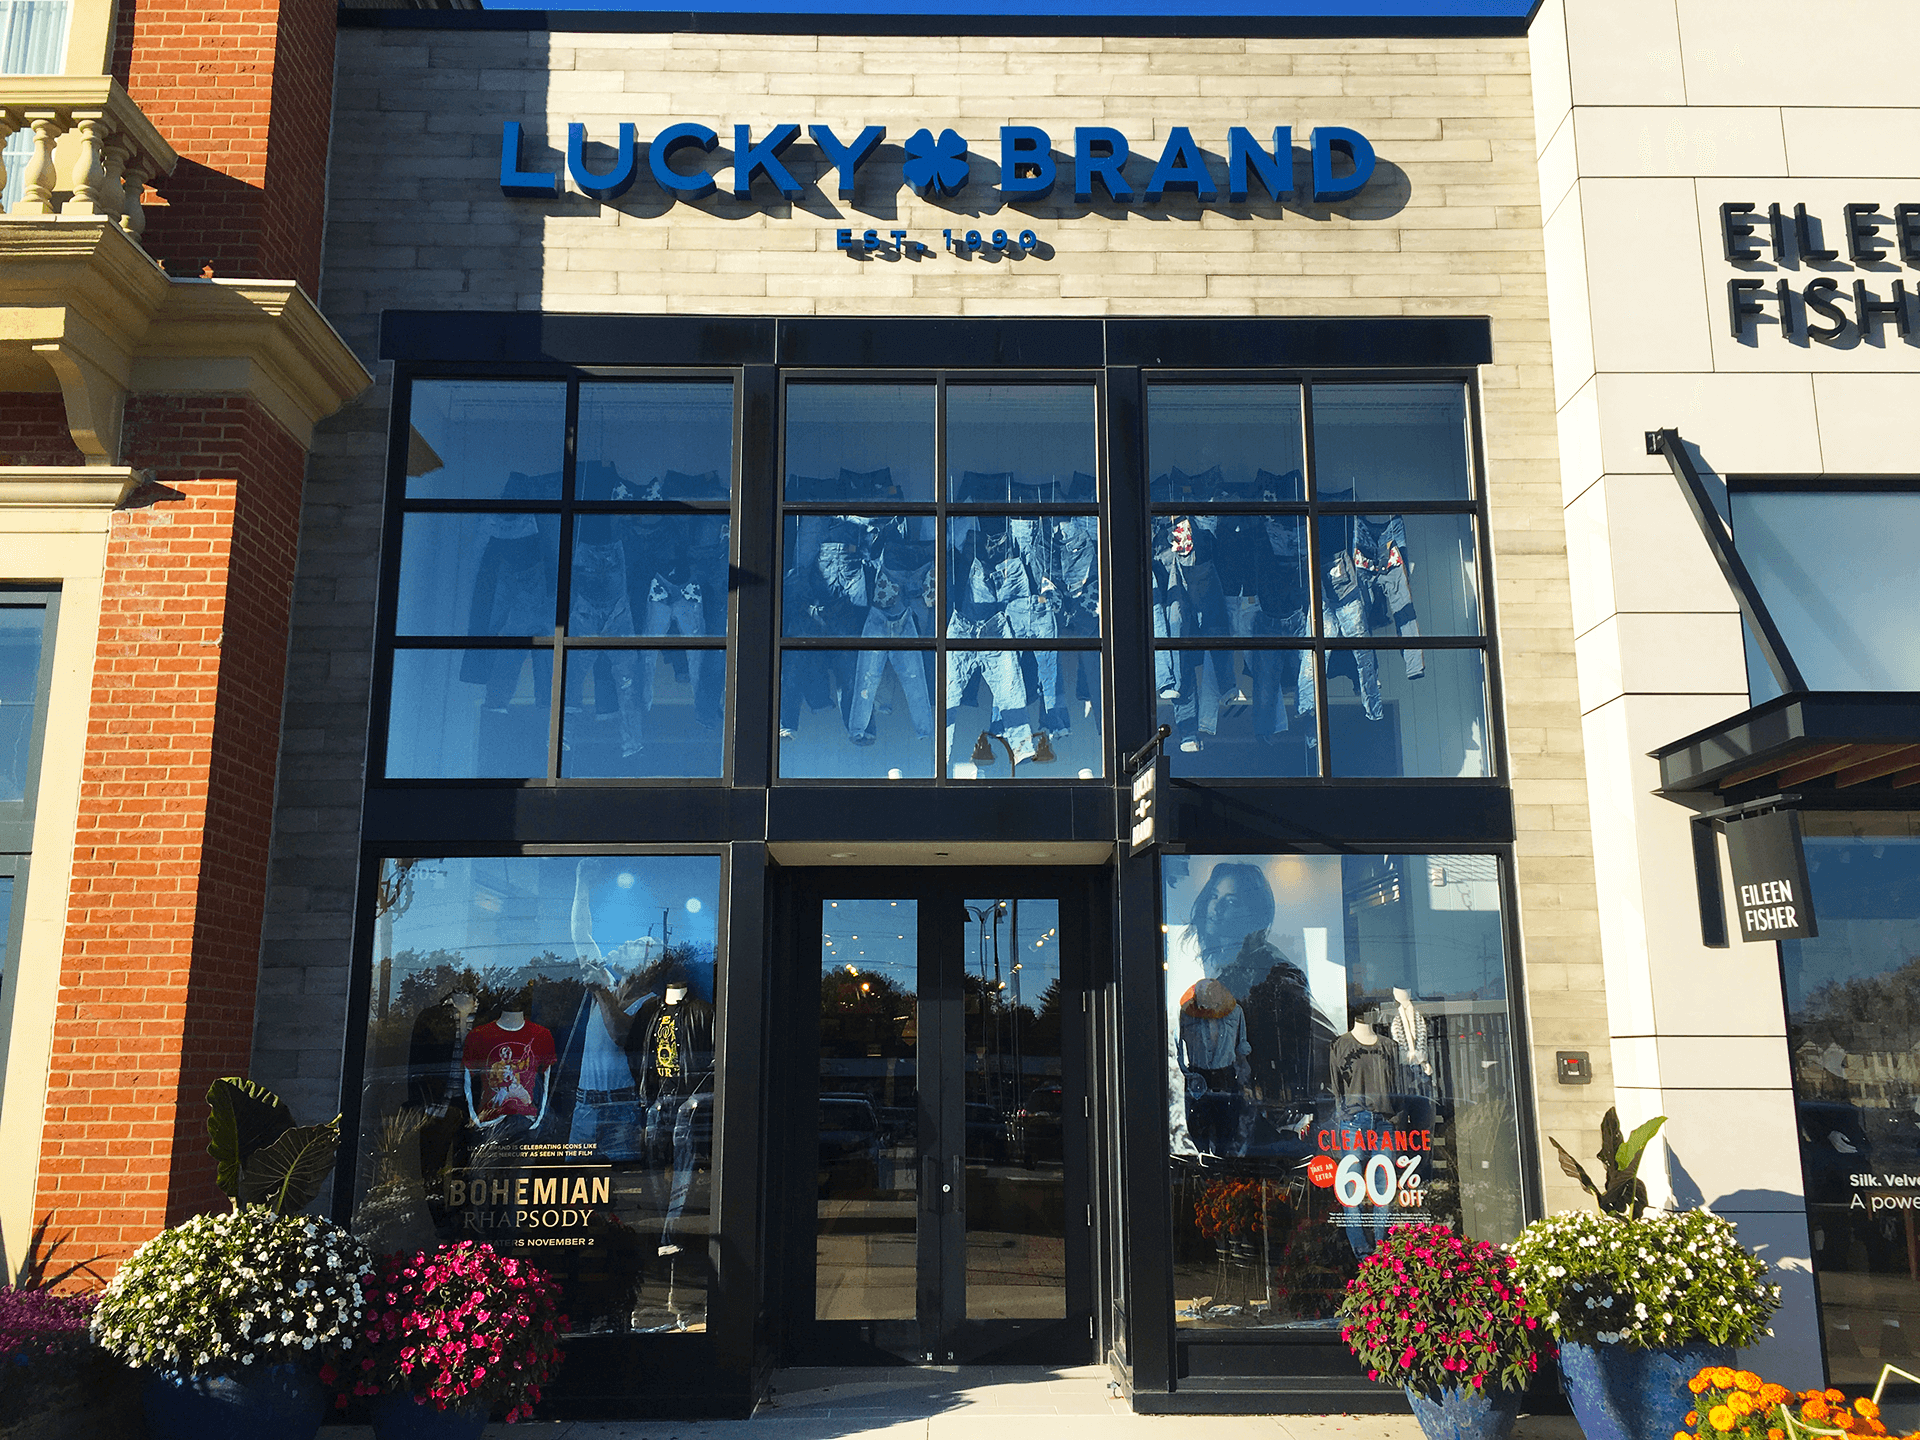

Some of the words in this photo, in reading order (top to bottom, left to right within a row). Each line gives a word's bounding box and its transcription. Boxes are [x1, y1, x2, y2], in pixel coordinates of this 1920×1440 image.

[500, 121, 887, 201] LUCKY
[1000, 126, 1378, 202] BRAND
[836, 229, 928, 252] EST.
[943, 229, 1038, 253] 1990
[1727, 277, 1920, 338] FISH
[1741, 879, 1793, 907] EILEEN
[1745, 906, 1798, 932] FISHER
[1317, 1129, 1431, 1151] CLEARANCE
[1310, 1164, 1323, 1174] TAKE
[1315, 1173, 1333, 1181] EXTRA
[1334, 1154, 1422, 1207] 60%
[1849, 1173, 1882, 1187] Silk.
[449, 1177, 610, 1207] BOHEMIAN
[1850, 1193, 1866, 1209] A
[463, 1209, 594, 1234] RHAPSODY
[527, 1238, 586, 1247] NOVEMBER
[587, 1237, 595, 1246] 2
